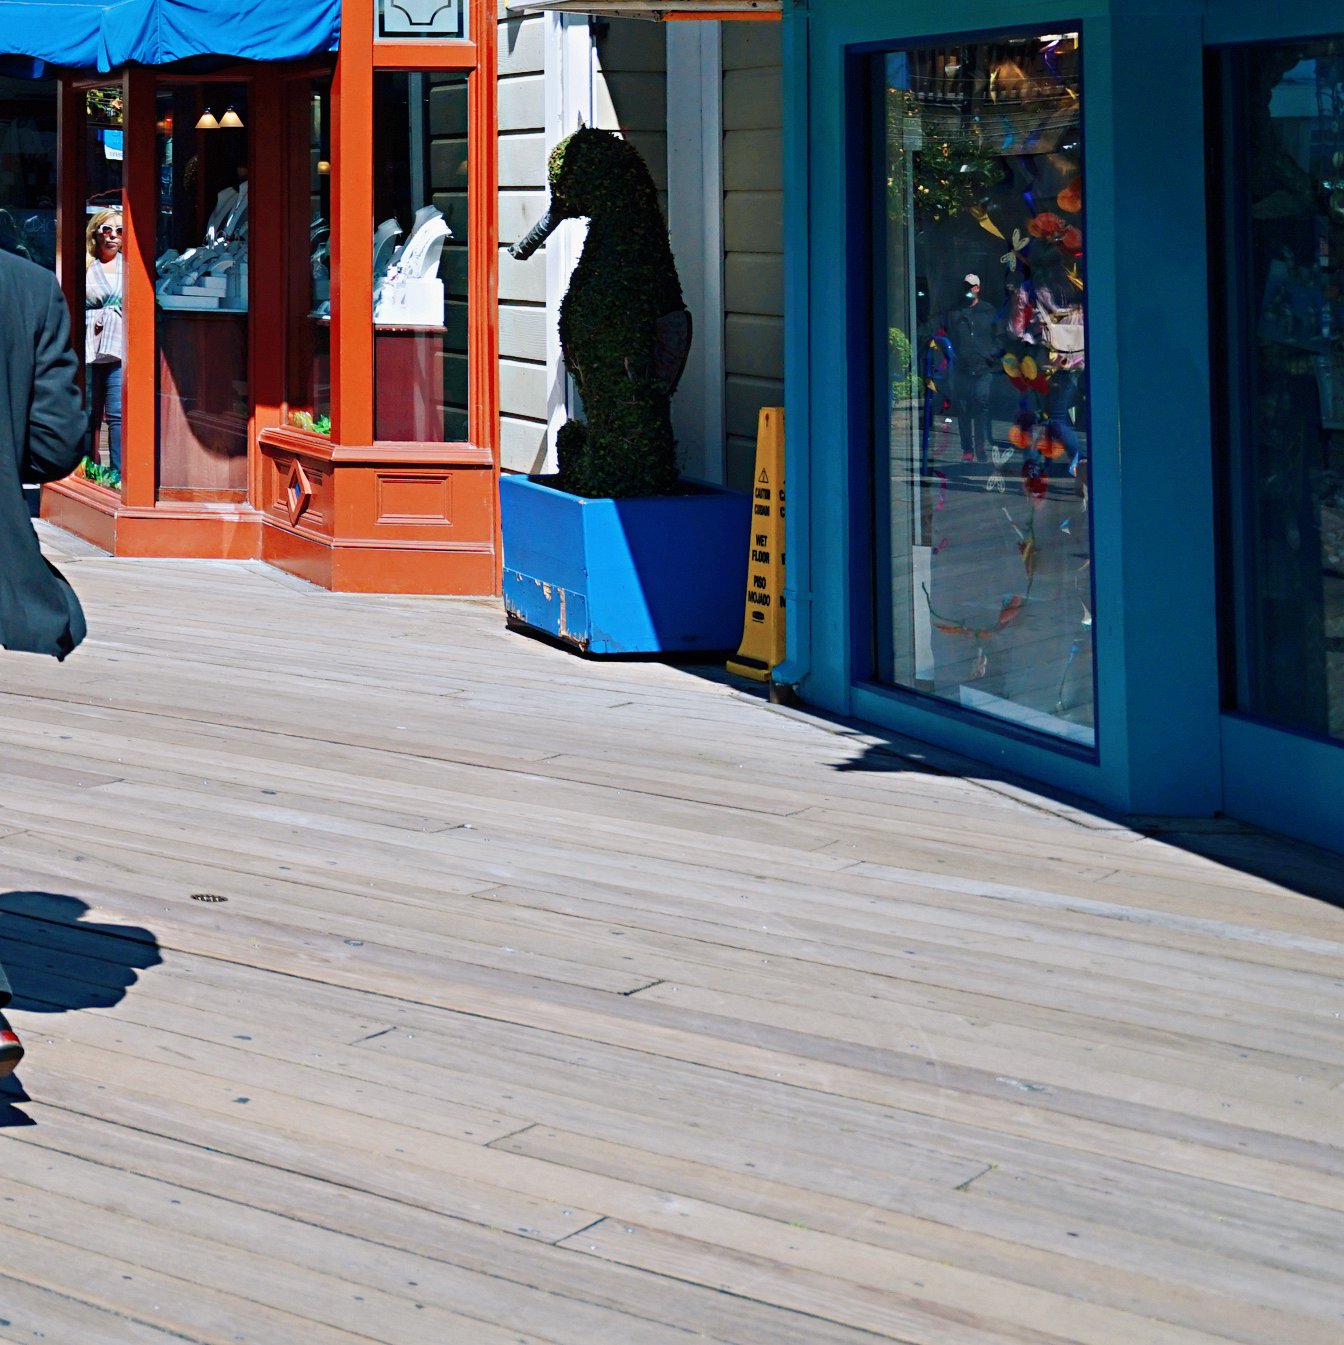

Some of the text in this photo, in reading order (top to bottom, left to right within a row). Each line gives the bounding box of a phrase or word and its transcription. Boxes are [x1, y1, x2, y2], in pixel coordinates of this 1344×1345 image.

[755, 534, 768, 548] WET
[752, 549, 770, 565] FLOOR
[753, 575, 767, 590] PISO
[747, 591, 771, 607] MOJADO
